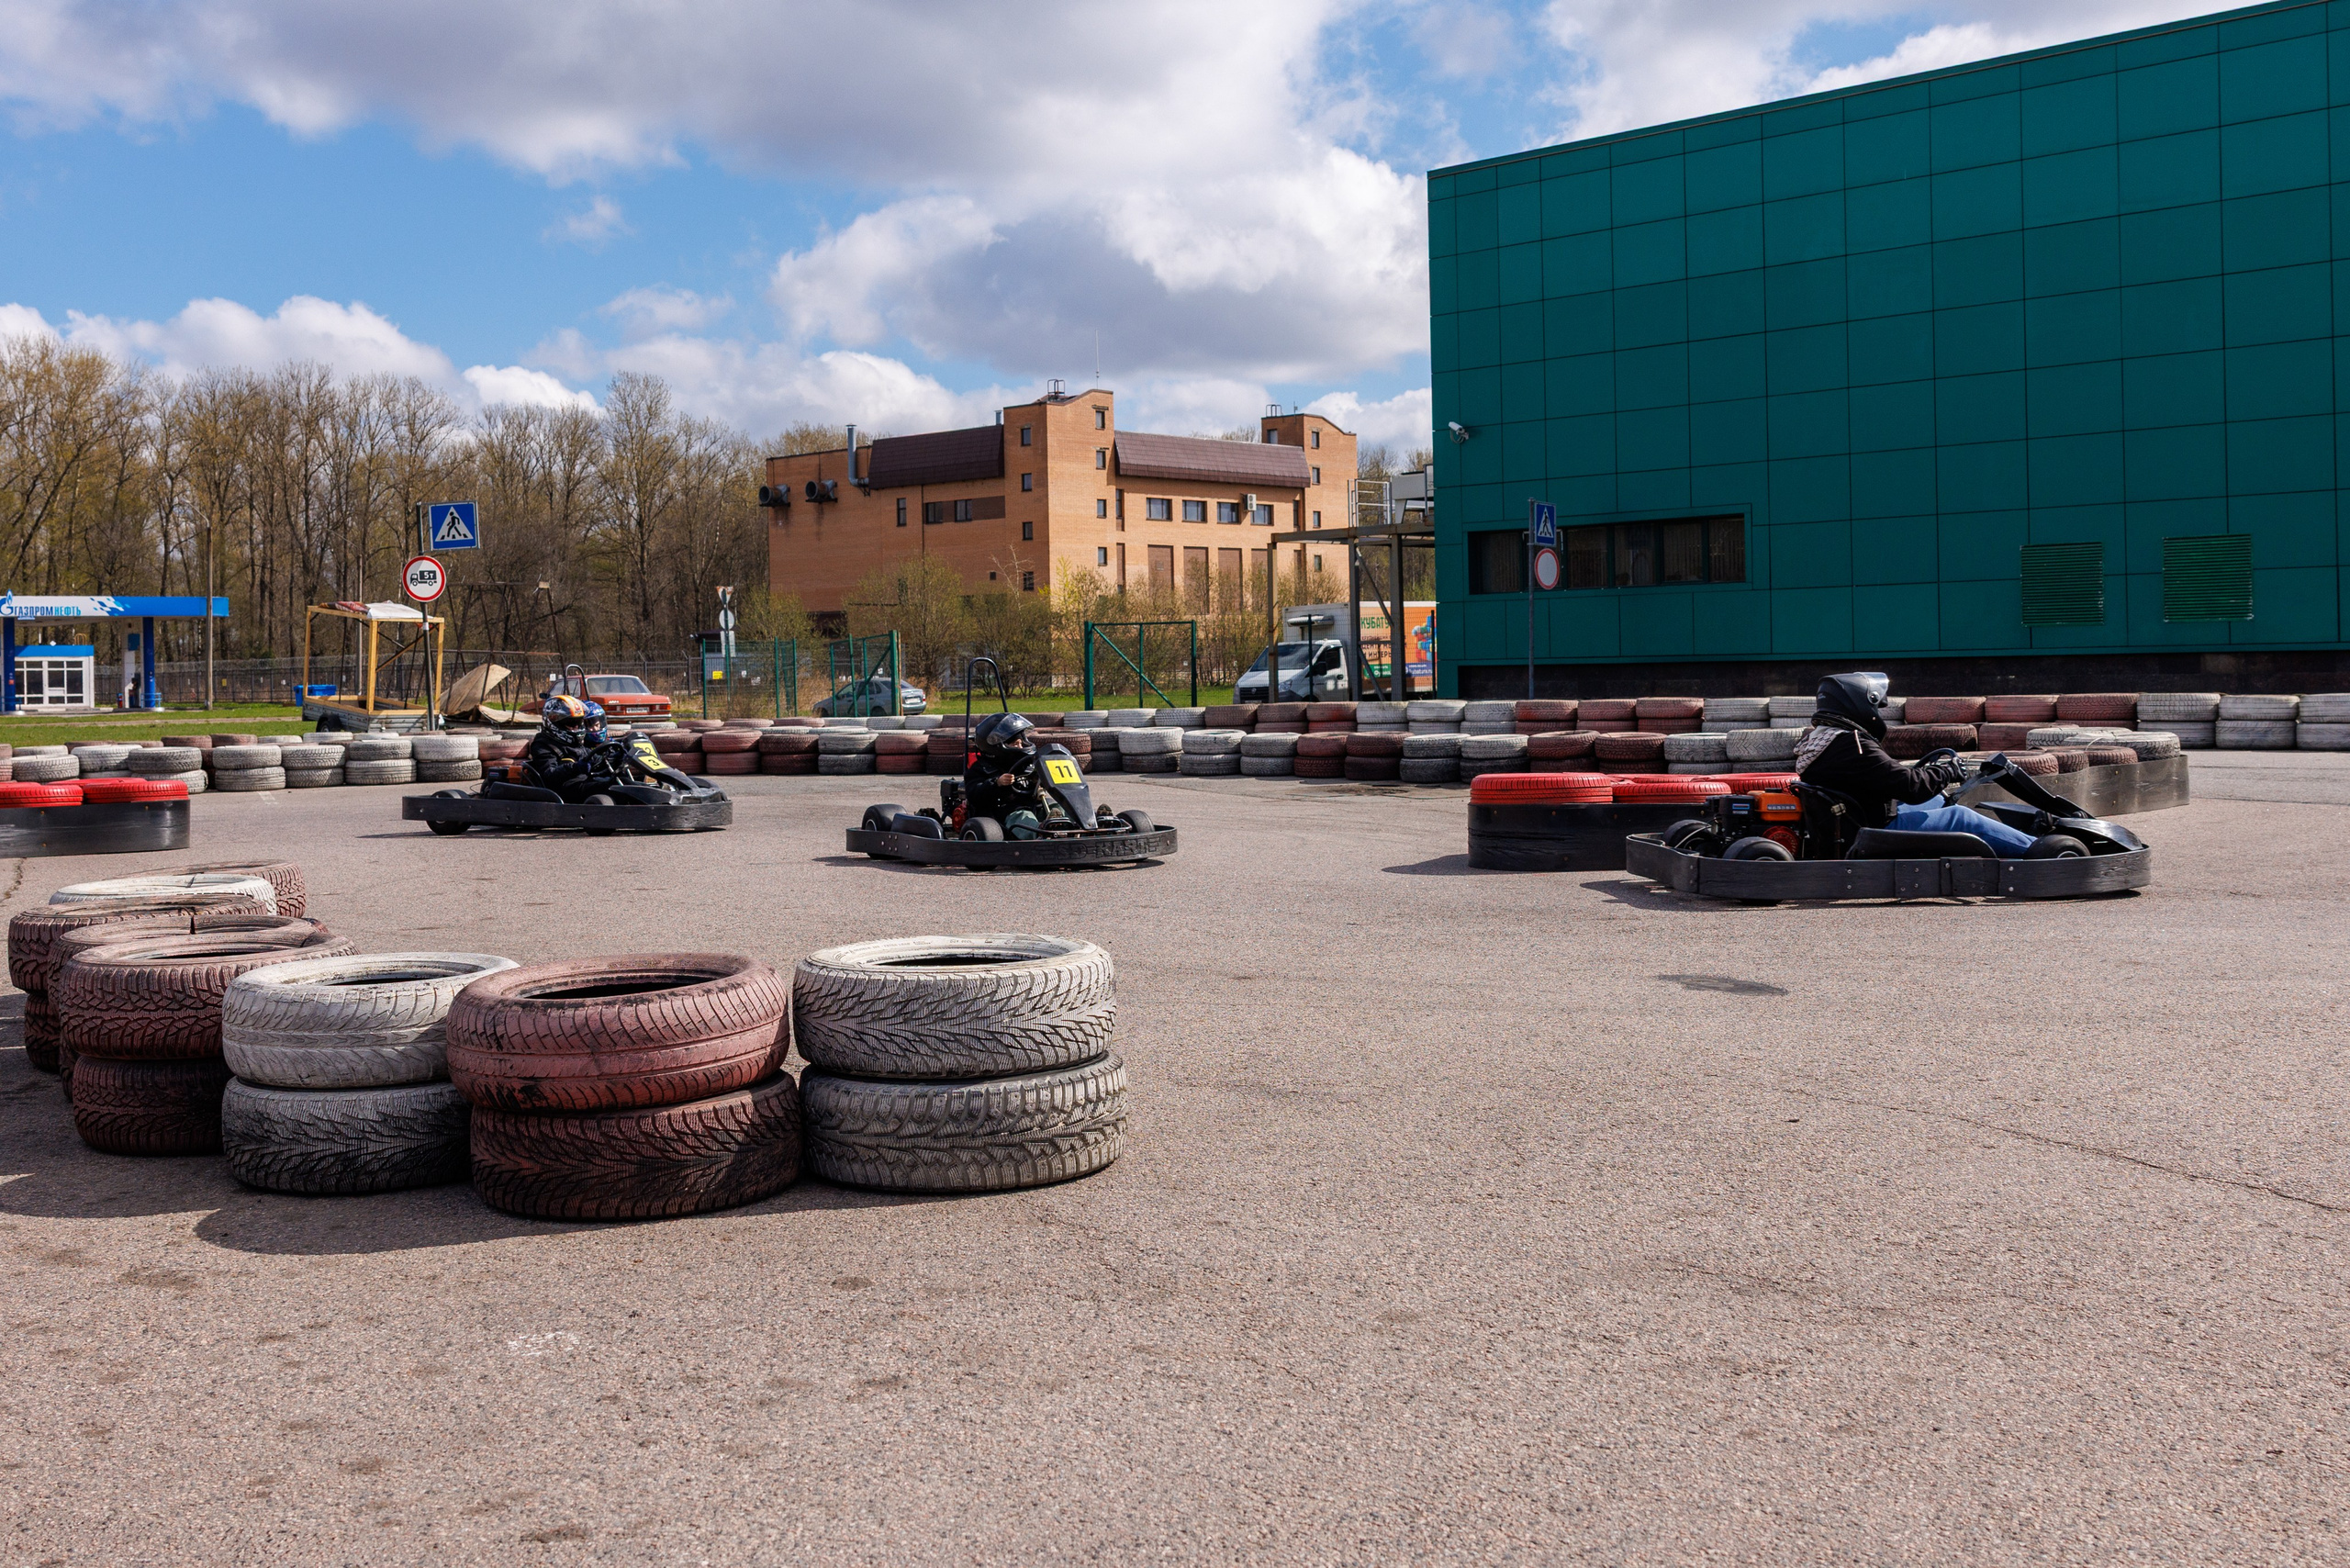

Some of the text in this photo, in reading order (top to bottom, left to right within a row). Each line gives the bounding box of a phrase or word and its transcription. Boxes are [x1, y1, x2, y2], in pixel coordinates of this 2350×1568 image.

[14, 606, 82, 616] ГАЗПРОМНЕФТЬ
[1360, 617, 1390, 628] КУБАТУ
[1056, 766, 1072, 778] 11
